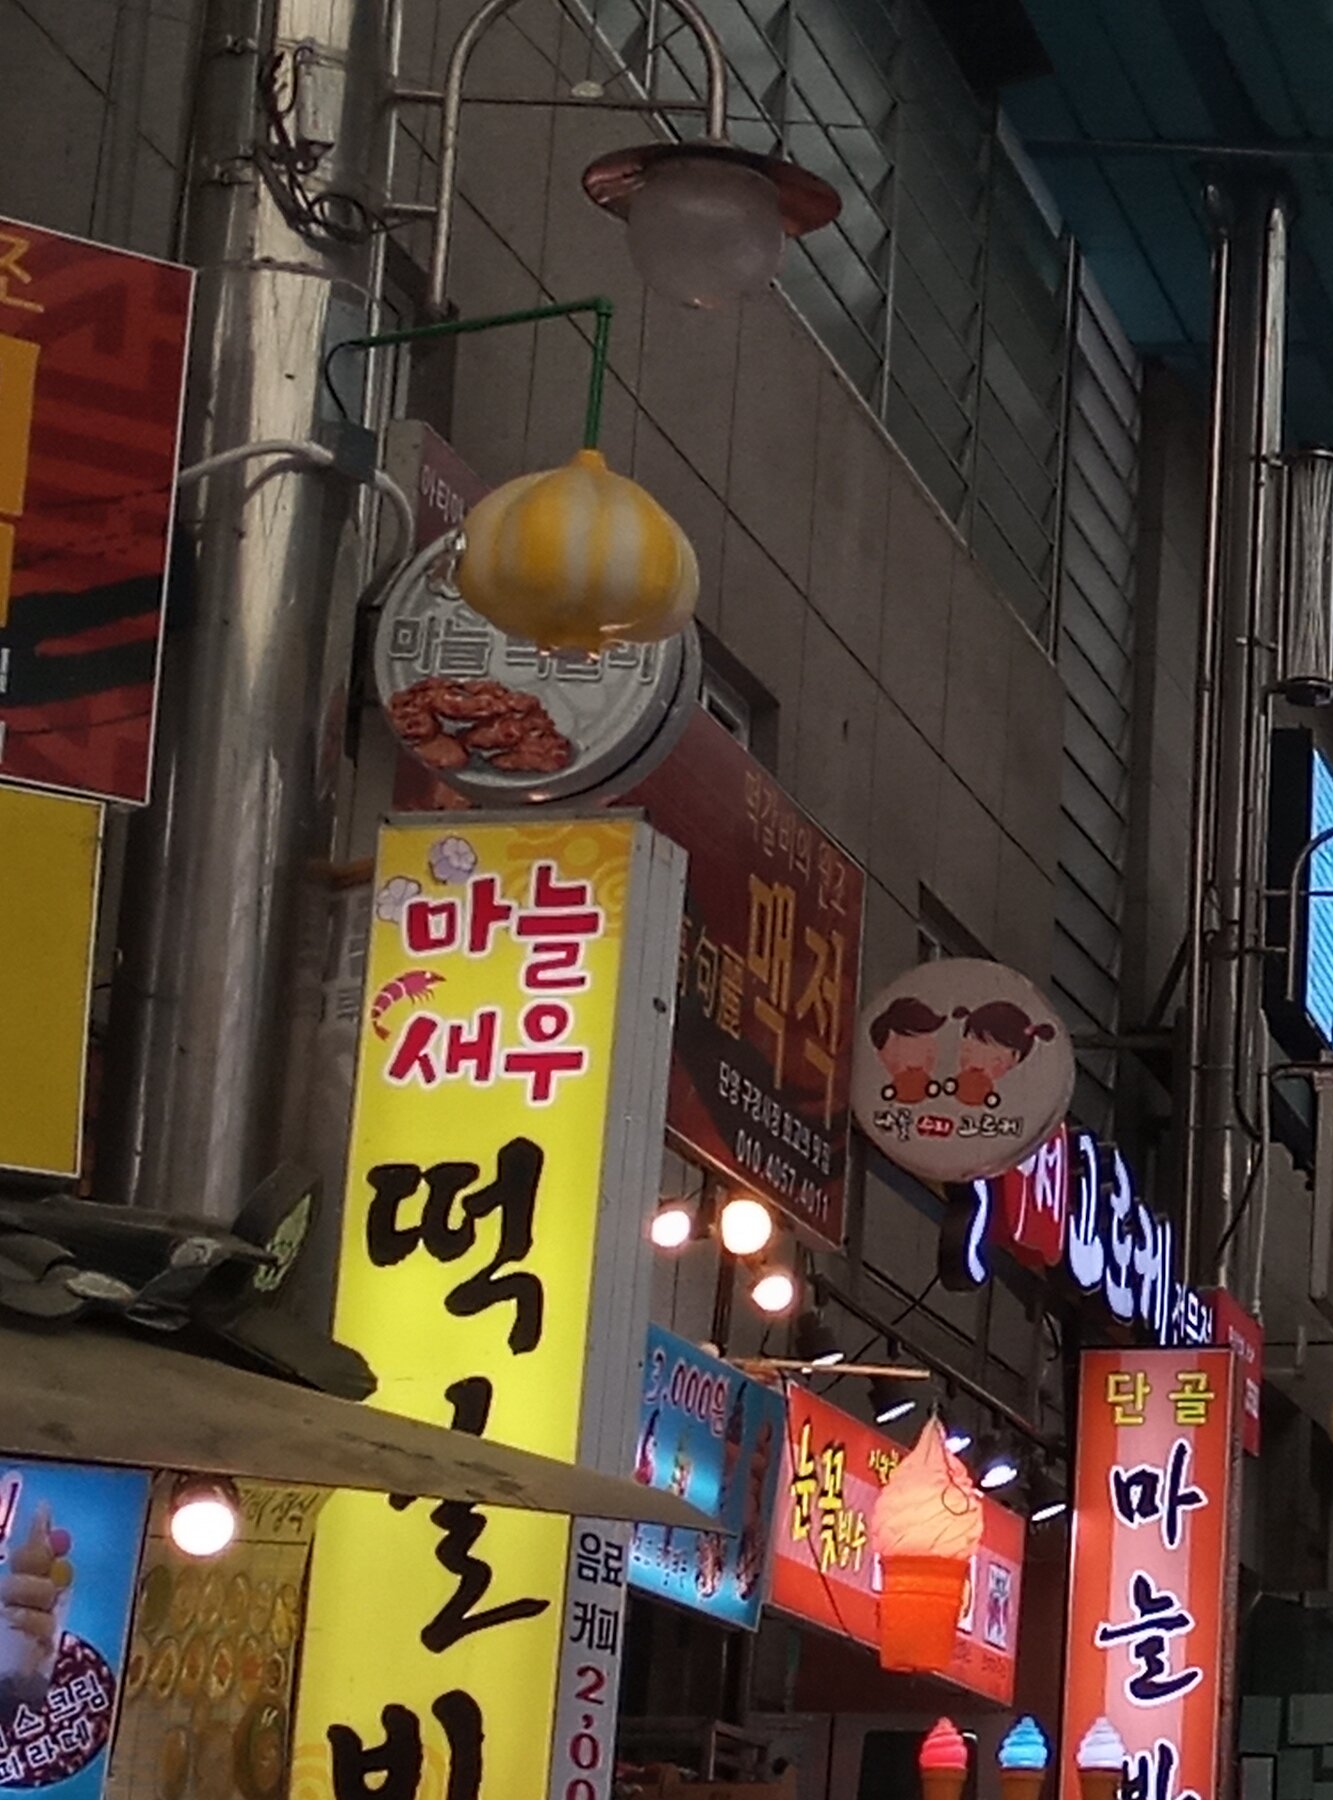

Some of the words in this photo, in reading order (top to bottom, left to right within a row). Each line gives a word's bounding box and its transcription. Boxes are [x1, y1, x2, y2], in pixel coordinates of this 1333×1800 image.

[404, 862, 600, 990] 마늘
[749, 872, 845, 1131] 맥적
[389, 1003, 584, 1101] 새우
[1107, 1370, 1215, 1426] 단골
[577, 1532, 624, 1588] 음료
[570, 1601, 620, 1656] 커피
